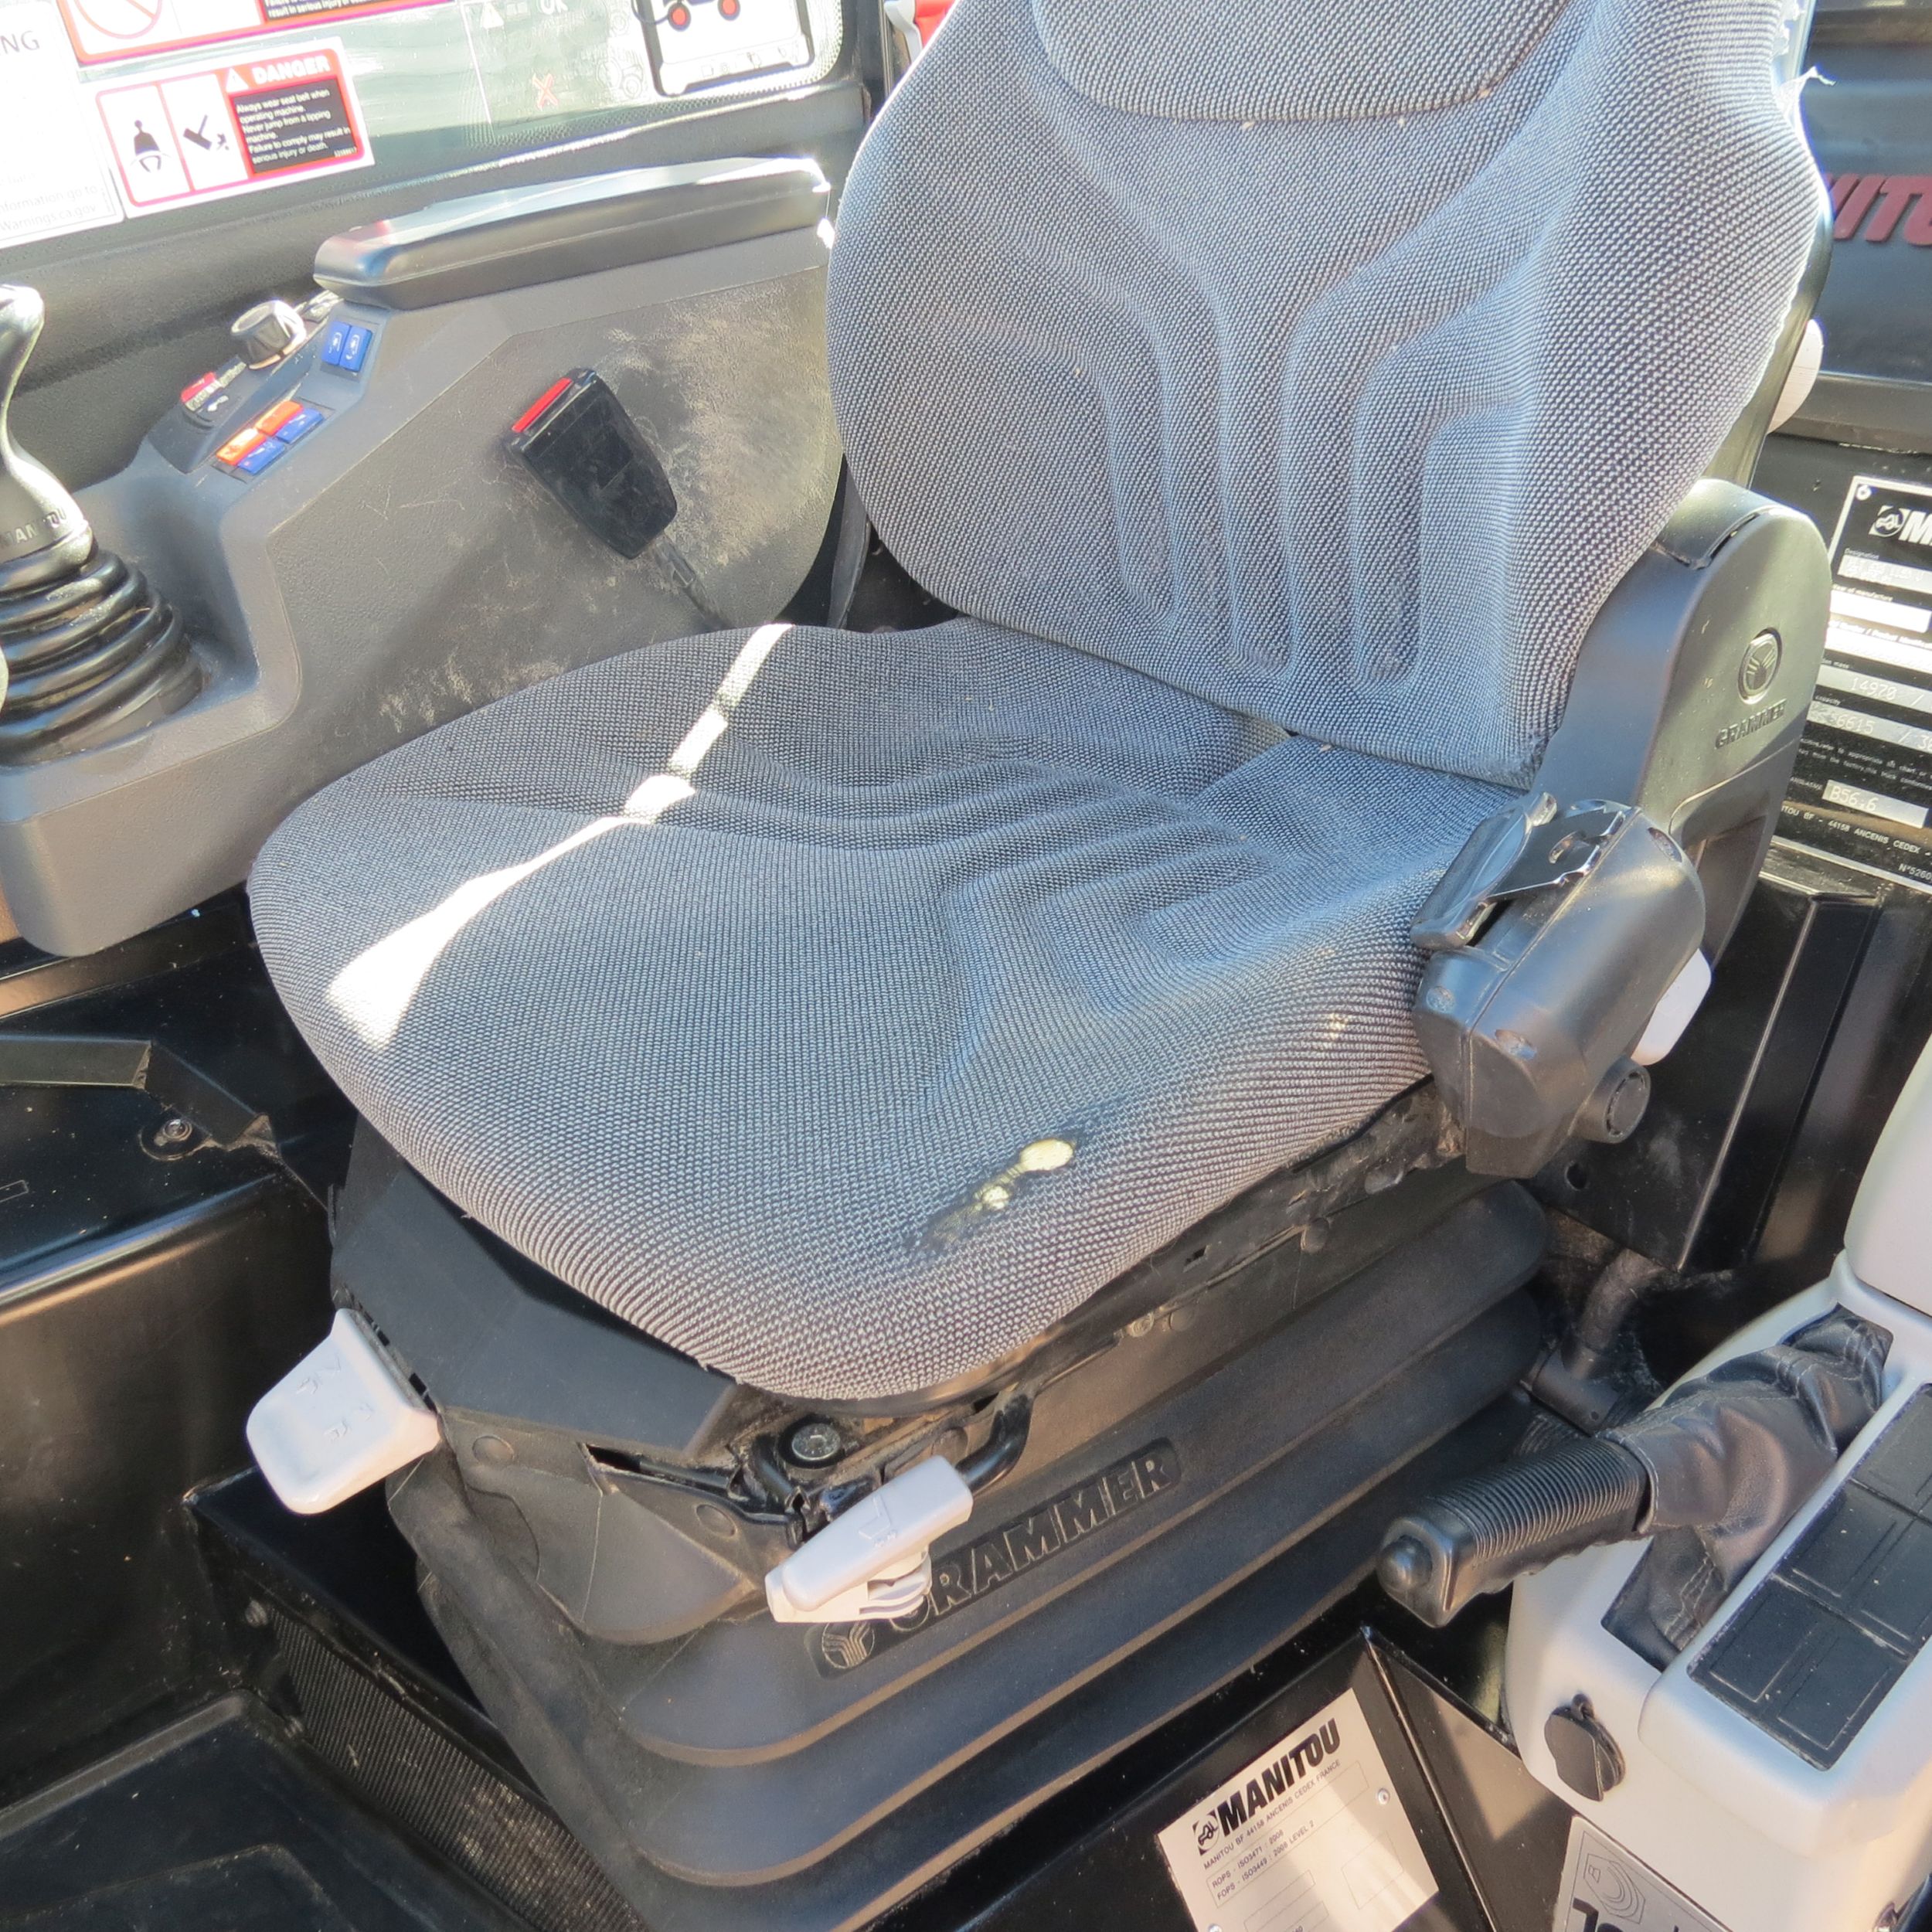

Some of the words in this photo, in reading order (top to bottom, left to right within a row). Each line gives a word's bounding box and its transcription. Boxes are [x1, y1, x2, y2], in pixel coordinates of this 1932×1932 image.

[0, 29, 41, 55] NG
[252, 55, 331, 85] DANGER
[236, 102, 262, 114] Always
[263, 99, 280, 109] wear
[281, 95, 297, 105] seat
[297, 92, 311, 103] belt
[311, 89, 331, 99] when
[240, 111, 274, 124] operating
[274, 105, 306, 117] machine.
[243, 124, 264, 134] Never
[265, 120, 284, 131] jump
[283, 116, 301, 126] from
[307, 110, 332, 122] tipping
[246, 131, 278, 144] machine.
[249, 143, 273, 155] Failure
[274, 141, 281, 149] to
[282, 134, 308, 147] comply
[308, 133, 323, 143] may
[324, 128, 343, 139] result
[252, 152, 278, 165] serious
[278, 148, 298, 160] injury
[66, 189, 83, 205] go
[84, 184, 98, 196] to
[1845, 547, 1879, 560] Designation
[1856, 589, 1893, 603] manufacture
[1715, 698, 1787, 749] GRAMMER
[1849, 751, 1883, 765] appropriate
[1854, 828, 1889, 844] ANCENIS
[1893, 839, 1921, 855] CEDEX
[1217, 1717, 1341, 1838] MANITOU
[1203, 1842, 1235, 1870] MANITOU
[1236, 1835, 1245, 1846] BF
[1247, 1821, 1265, 1836] 44158
[1266, 1798, 1294, 1821] ANCENIS
[1294, 1781, 1316, 1799] CEDEX
[1315, 1759, 1341, 1782] FRANCE
[1212, 1870, 1232, 1888] ROPS
[1237, 1845, 1263, 1869] ISO3471
[1217, 1883, 1236, 1900] FOPS
[1242, 1858, 1267, 1881] ISO3449
[1273, 1841, 1289, 1856] 2008
[1289, 1827, 1309, 1844] LEVEL
[1309, 1819, 1315, 1828] 2
